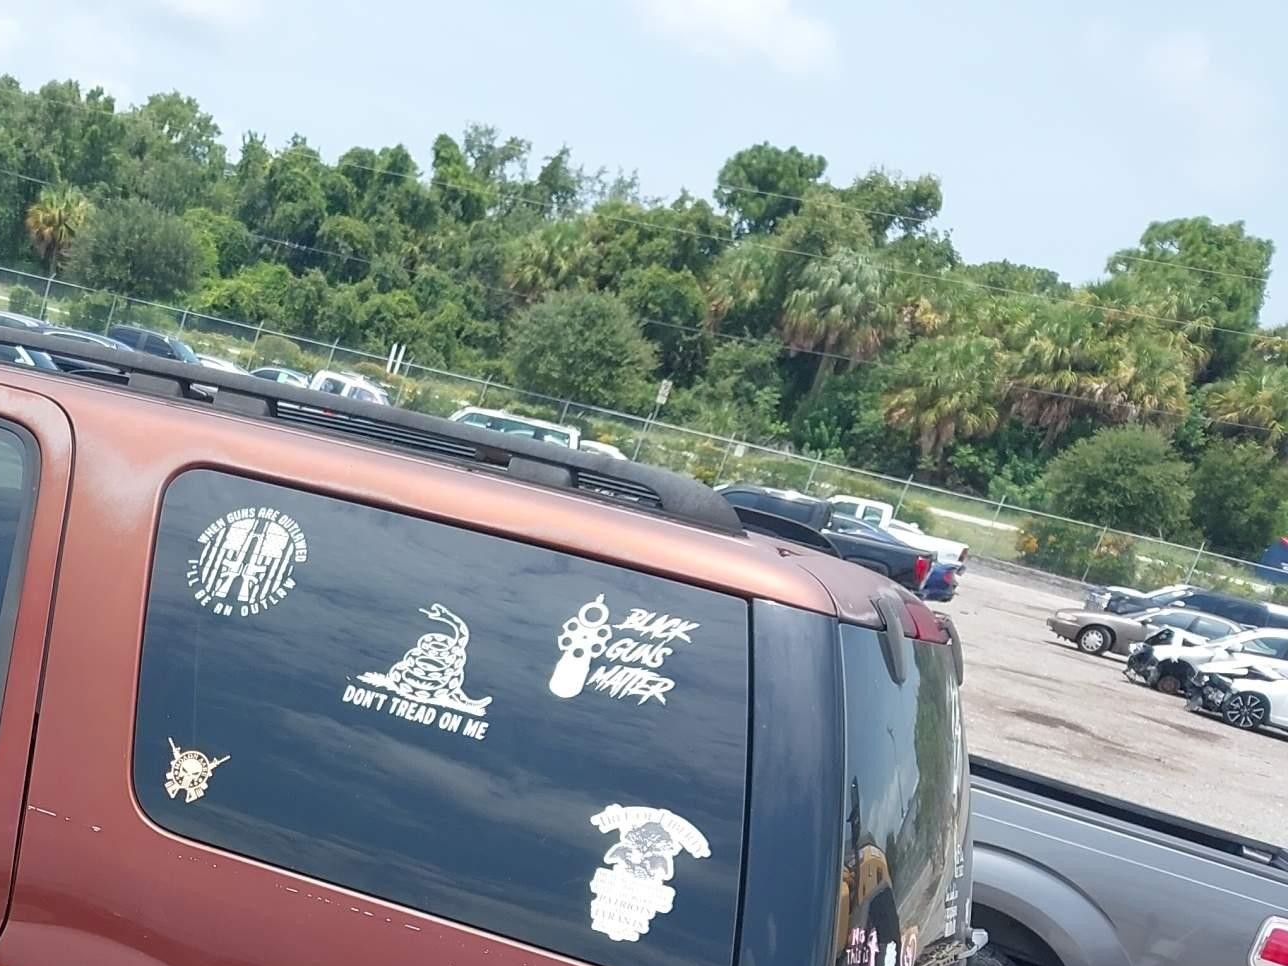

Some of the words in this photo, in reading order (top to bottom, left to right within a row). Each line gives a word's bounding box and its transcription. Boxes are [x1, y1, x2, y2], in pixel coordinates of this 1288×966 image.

[197, 517, 226, 544] WHEN
[226, 507, 256, 524] GUNS
[257, 507, 280, 521] ARE
[277, 514, 308, 562] OUTLAWED
[194, 589, 212, 607] BE
[213, 602, 233, 617] AN
[240, 577, 296, 617] OUTLAW
[612, 608, 701, 643] BLACK
[605, 638, 673, 668] GUNS
[585, 665, 676, 706] MATTER
[342, 684, 388, 711] DON'T
[389, 697, 437, 725] TREAD
[438, 711, 463, 733] ON
[462, 718, 490, 740] ME
[851, 927, 866, 946] NO
[845, 948, 861, 964] THIS
[862, 947, 869, 962] IS
